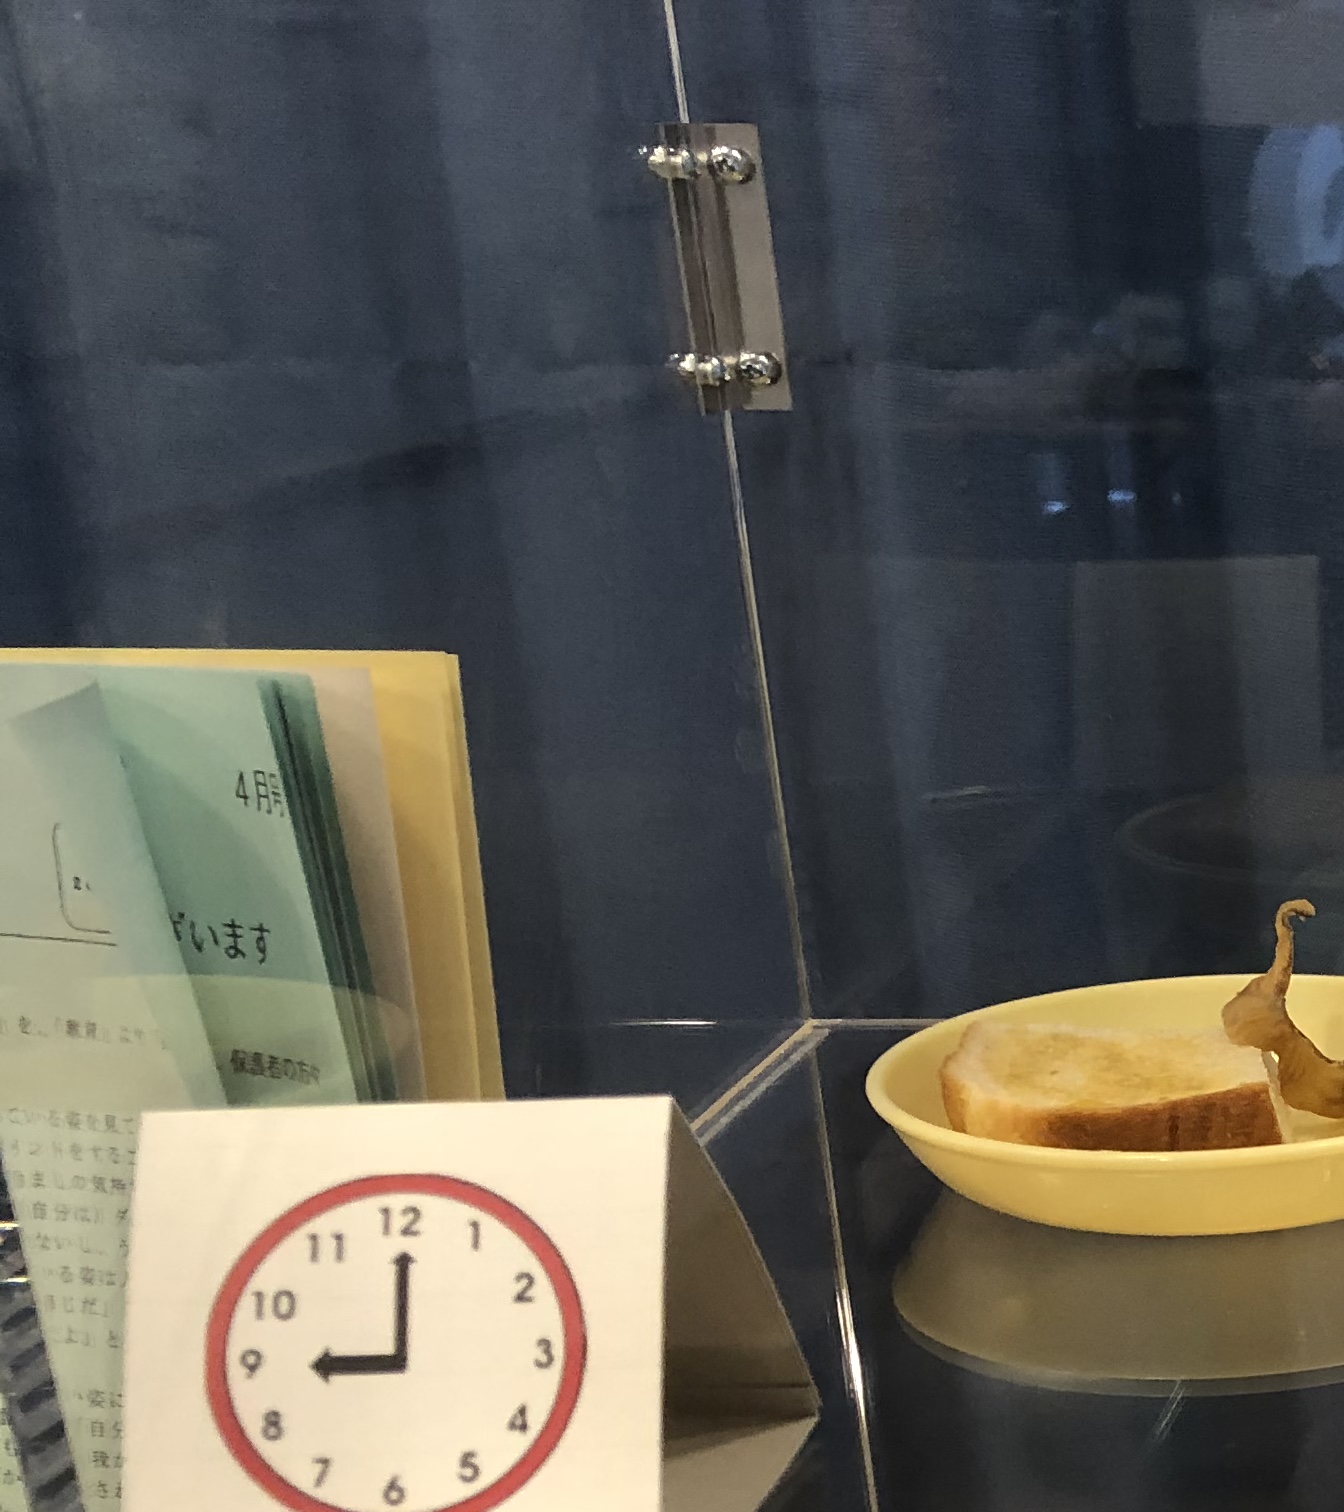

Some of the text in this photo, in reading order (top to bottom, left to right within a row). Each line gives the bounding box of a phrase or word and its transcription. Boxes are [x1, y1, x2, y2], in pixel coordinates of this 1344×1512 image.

[379, 1205, 422, 1237] 12
[468, 1219, 482, 1252] 1
[308, 1232, 345, 1263] 11
[513, 1272, 535, 1304] 2
[251, 1289, 297, 1322] 10
[239, 1348, 263, 1379] 9
[534, 1337, 555, 1370] 3
[261, 1409, 284, 1441] 8
[508, 1404, 529, 1434] 4
[314, 1456, 331, 1488] 7
[458, 1450, 481, 1484] 5
[382, 1476, 406, 1507] 6
